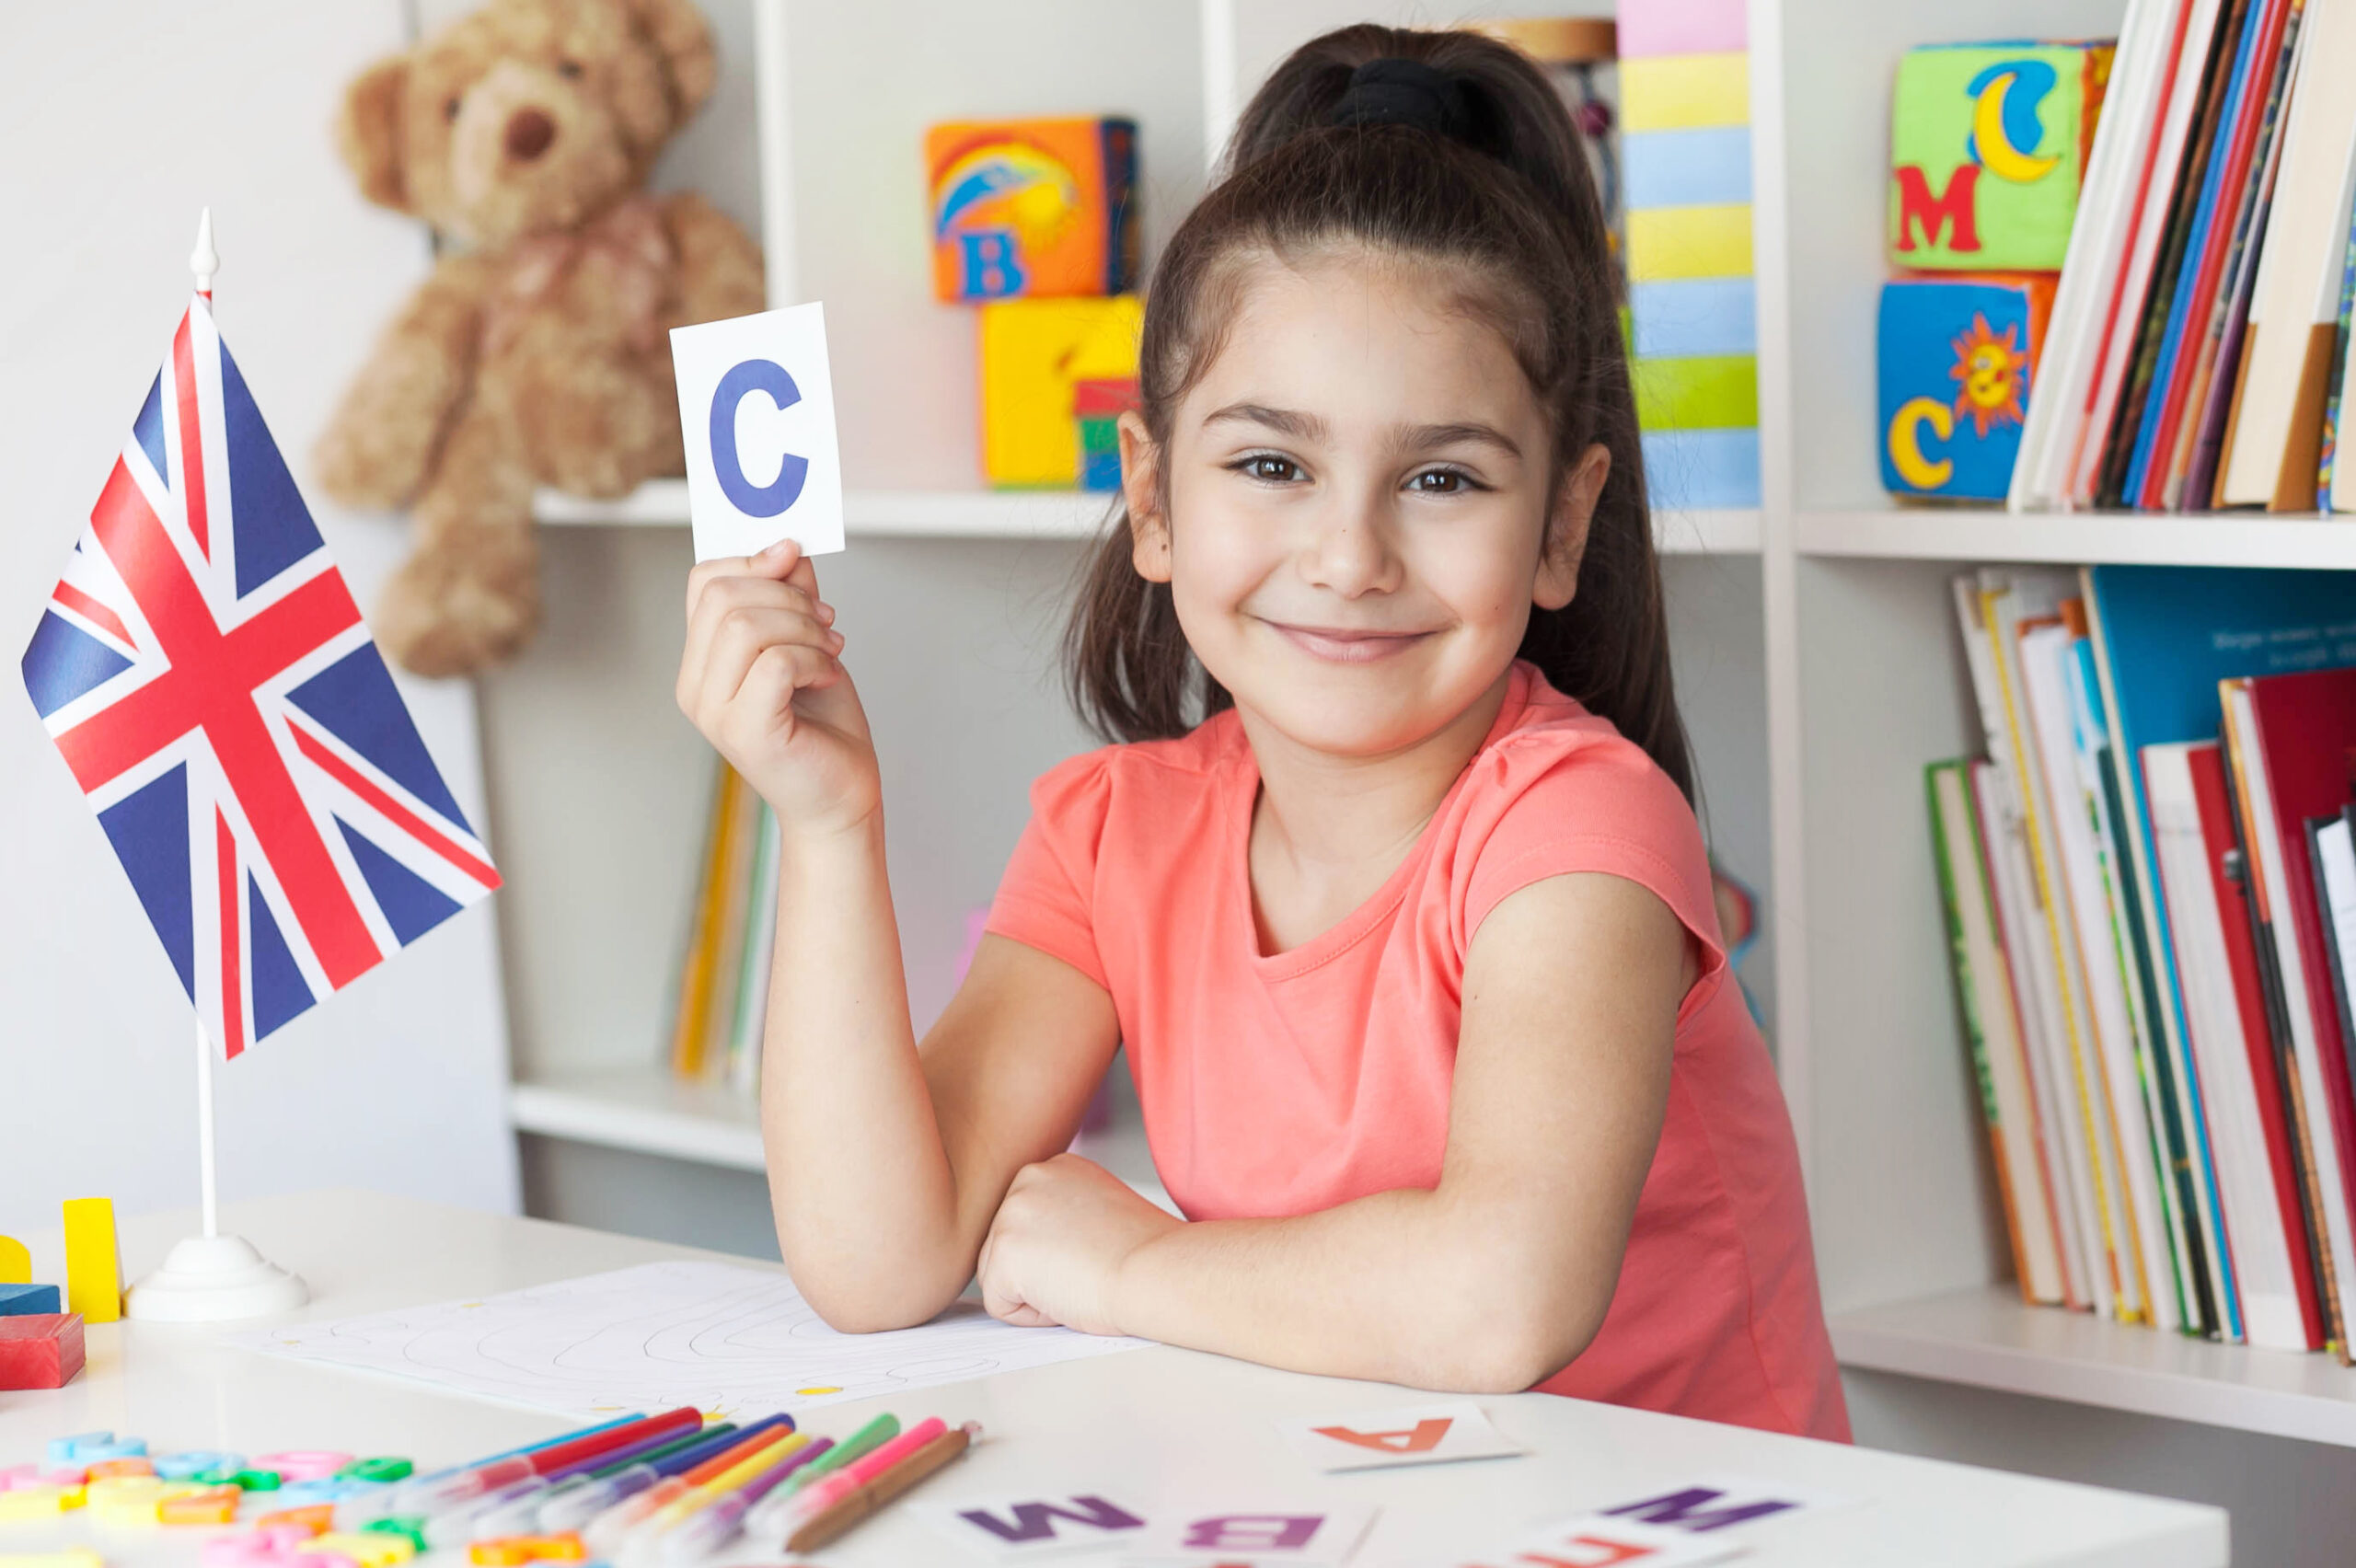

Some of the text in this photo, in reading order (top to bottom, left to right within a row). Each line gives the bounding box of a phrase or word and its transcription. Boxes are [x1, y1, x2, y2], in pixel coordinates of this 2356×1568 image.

[1894, 163, 1983, 253] M
[958, 230, 1027, 301] B
[709, 358, 809, 519] C
[1888, 396, 1953, 490] C
[1310, 1417, 1455, 1455] A
[1181, 1515, 1325, 1550] B
